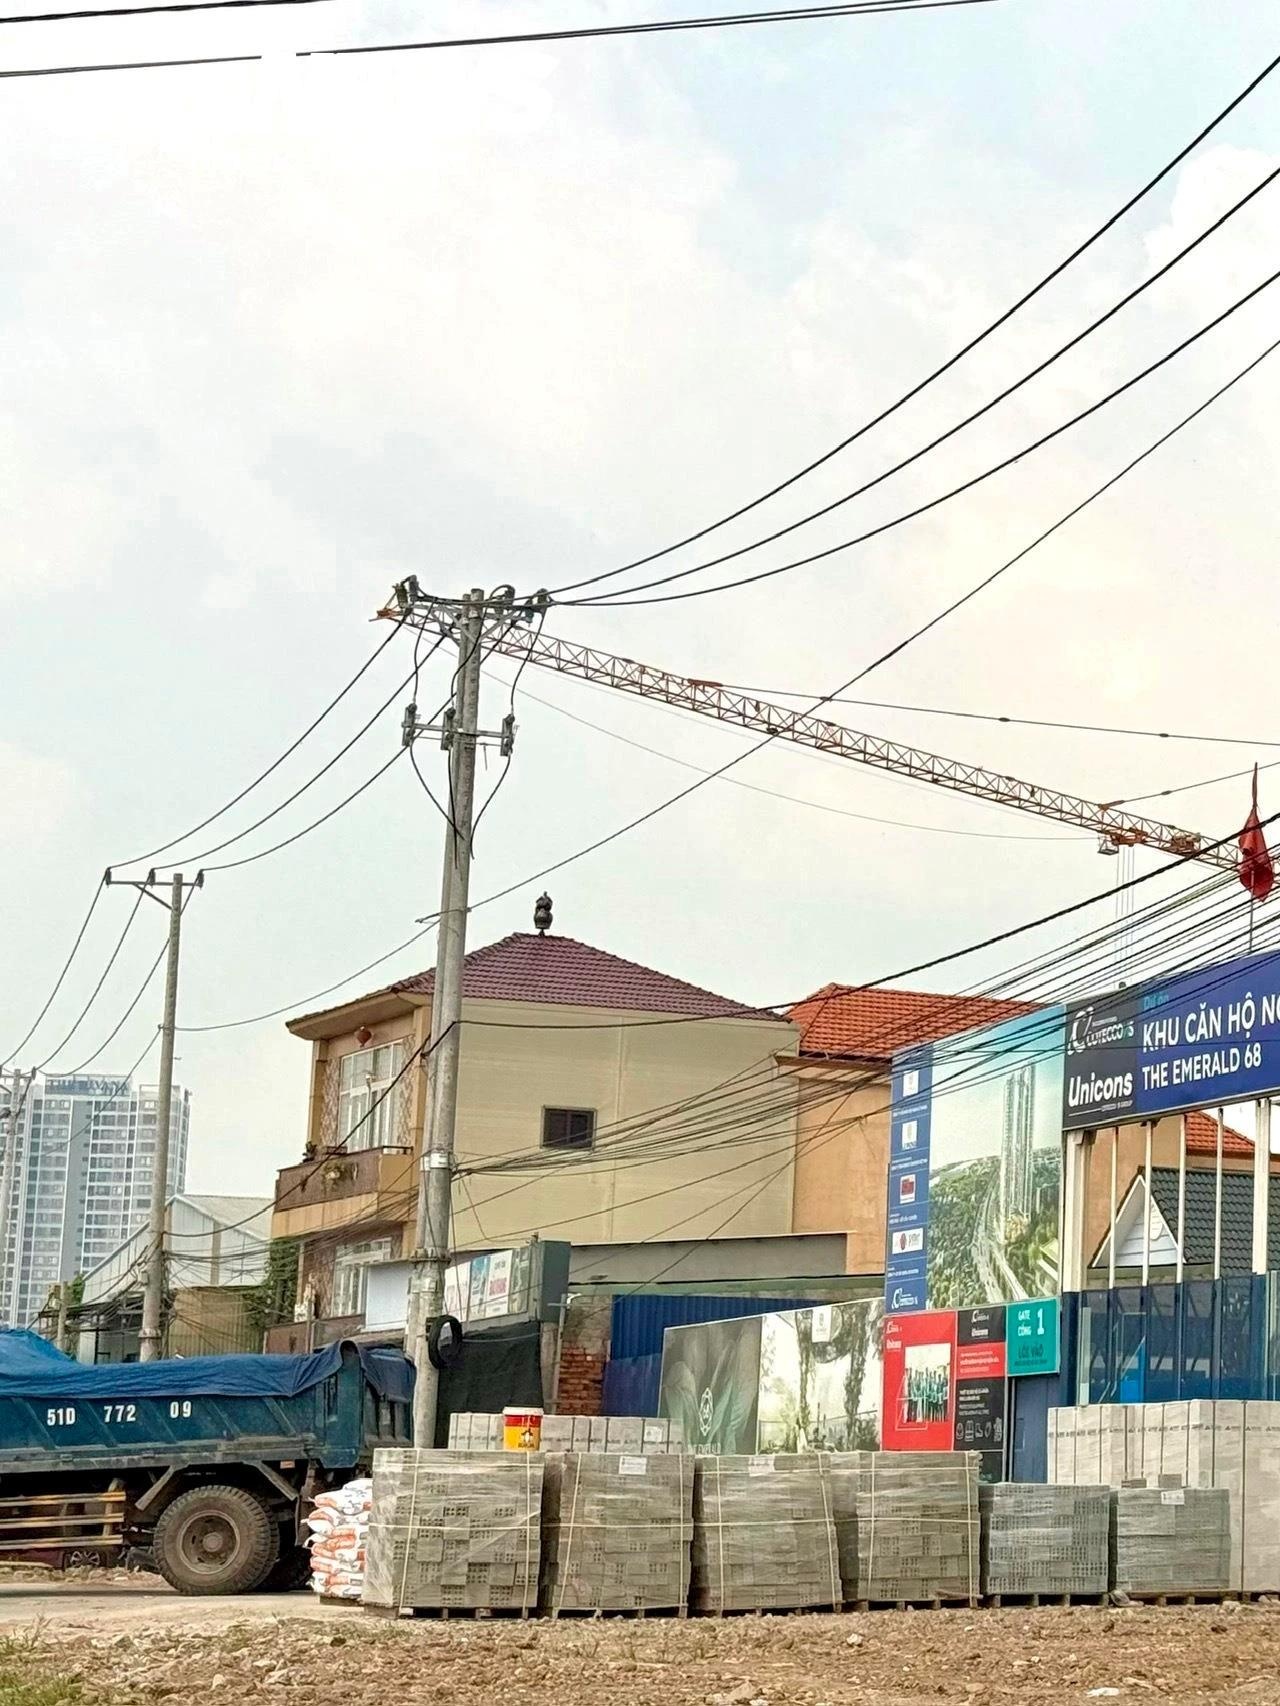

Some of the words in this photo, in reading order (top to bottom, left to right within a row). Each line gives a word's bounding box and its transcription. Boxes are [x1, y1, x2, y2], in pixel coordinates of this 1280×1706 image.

[1142, 1016, 1180, 1053] KHU
[1185, 1002, 1222, 1043] CĂN
[1228, 992, 1255, 1038] HỘ
[1142, 1062, 1169, 1091] THE
[1172, 1047, 1240, 1086] EMERALD
[1244, 1042, 1262, 1069] 68
[1068, 1071, 1134, 1107] Unicons
[1037, 1308, 1045, 1335] 1
[47, 1407, 76, 1426] 51D
[103, 1404, 136, 1423] 772
[169, 1400, 192, 1419] 09
